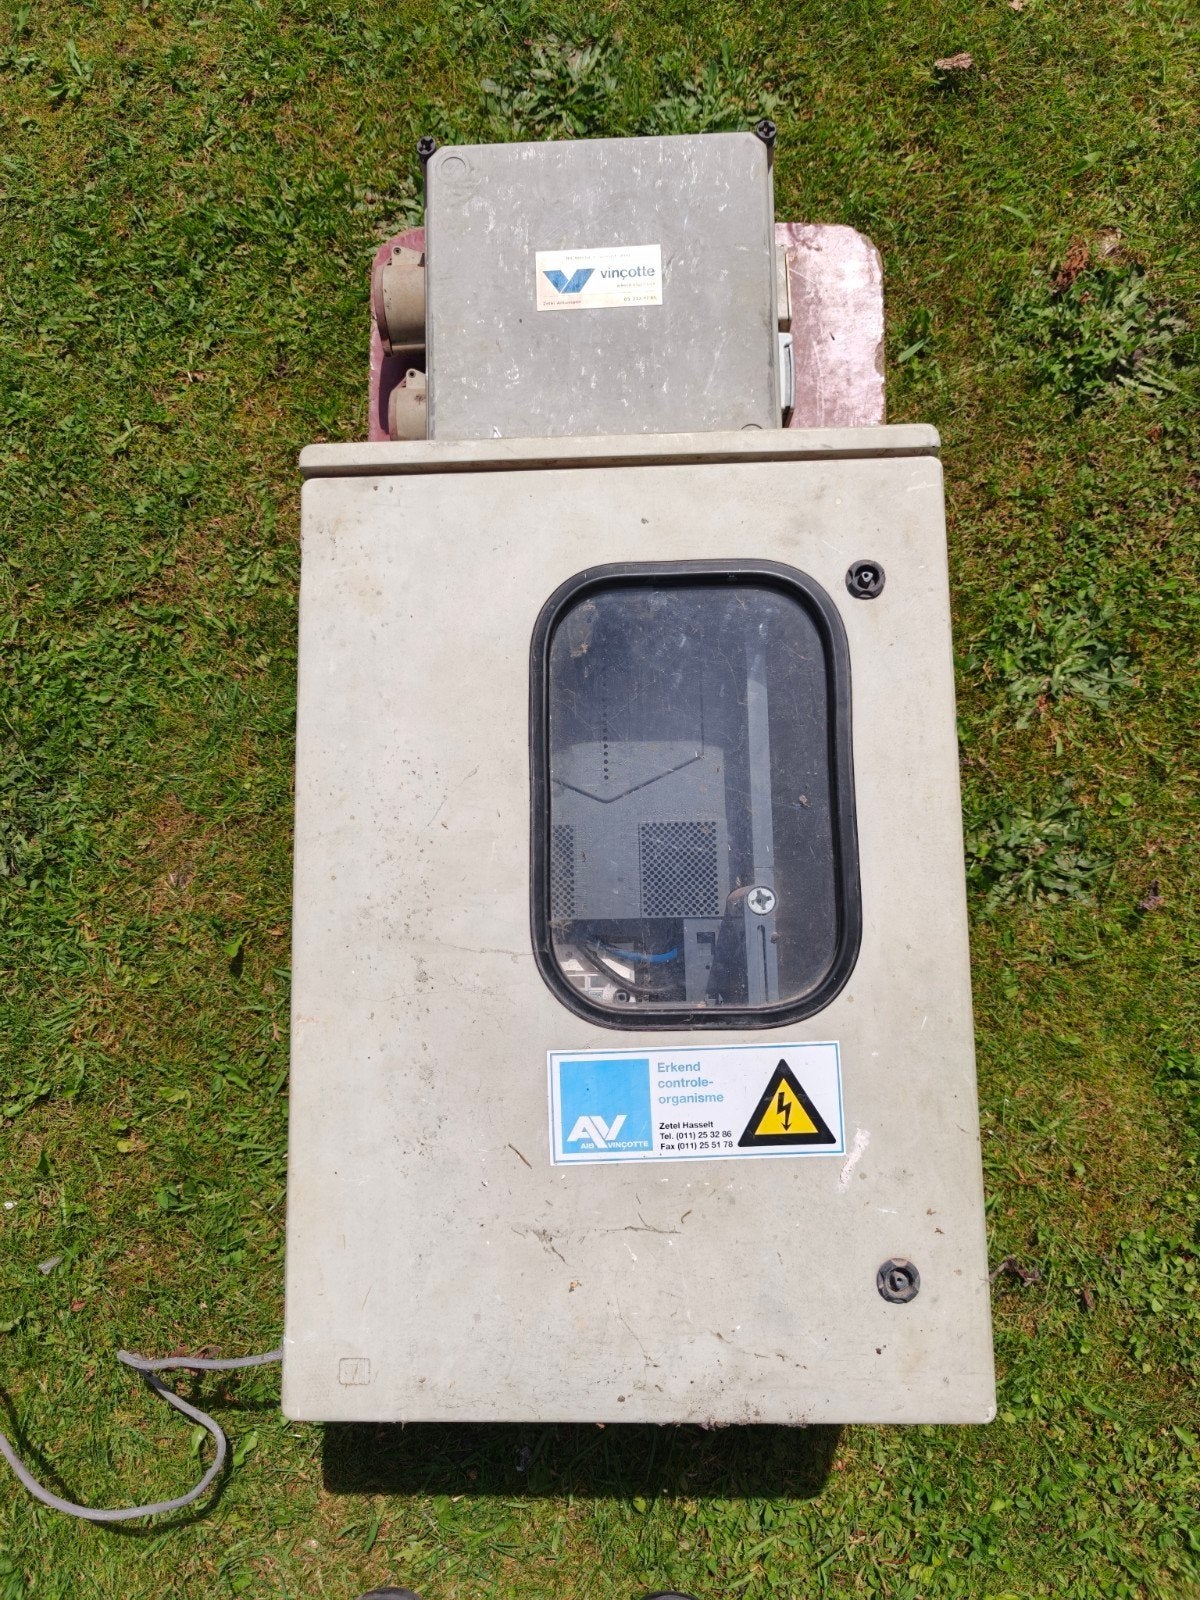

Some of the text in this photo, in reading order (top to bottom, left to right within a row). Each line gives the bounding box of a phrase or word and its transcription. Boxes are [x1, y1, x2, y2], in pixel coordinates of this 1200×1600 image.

[600, 266, 655, 280] vinçotte
[657, 1062, 701, 1073] Erkend
[658, 1077, 714, 1089] controle-
[658, 1093, 725, 1106] organisme
[659, 1120, 714, 1130] Zetel Hasselt
[660, 1132, 674, 1140] Tel.
[676, 1131, 696, 1141] (011)
[698, 1131, 708, 1139] 25
[721, 1130, 732, 1138] 86
[606, 1140, 649, 1150] VINÇOTTE
[677, 1142, 697, 1151] (011)
[699, 1141, 709, 1149] 25
[711, 1141, 721, 1149] 51
[723, 1140, 734, 1148] 78
